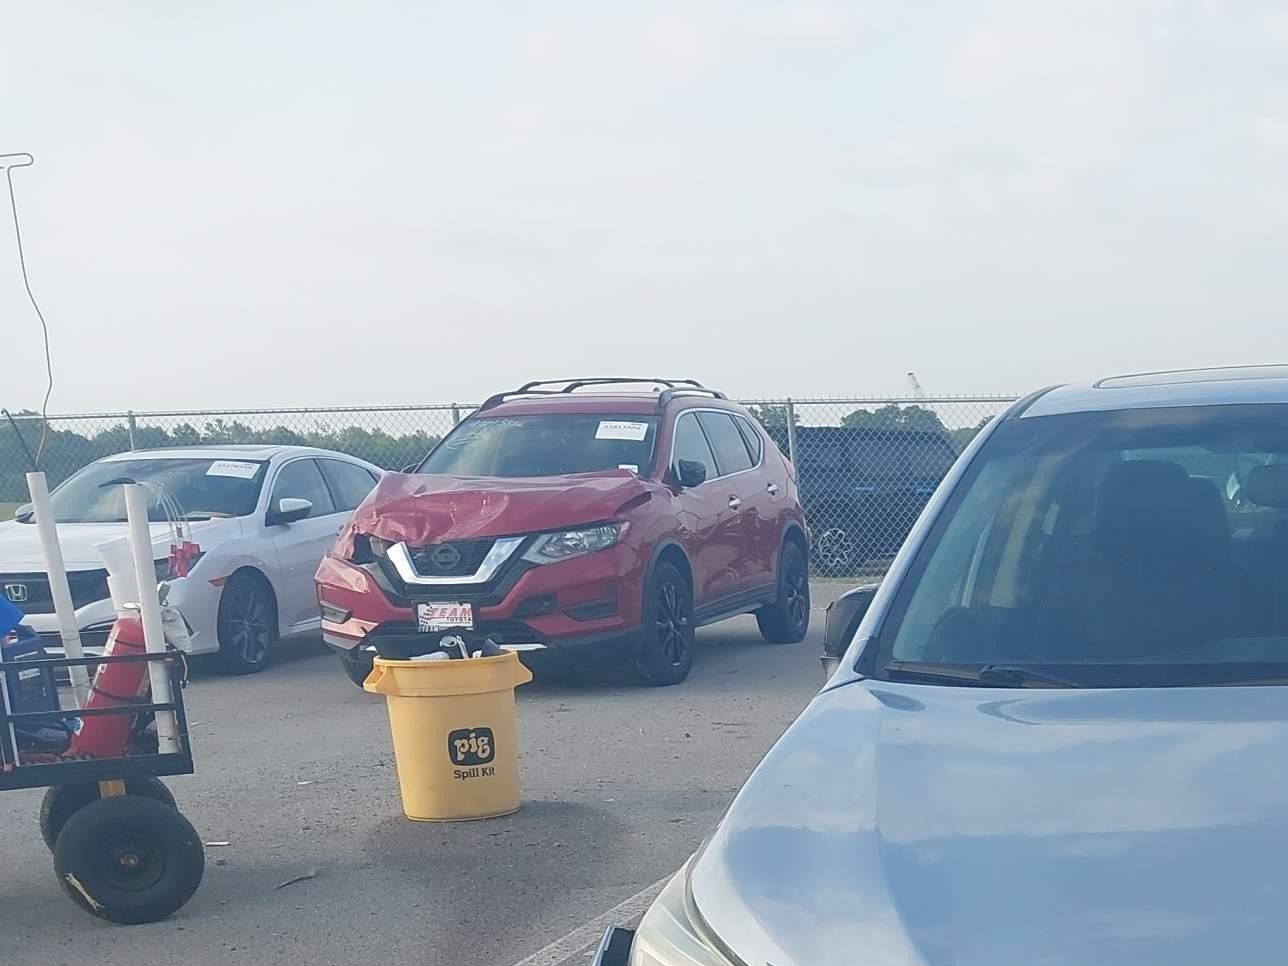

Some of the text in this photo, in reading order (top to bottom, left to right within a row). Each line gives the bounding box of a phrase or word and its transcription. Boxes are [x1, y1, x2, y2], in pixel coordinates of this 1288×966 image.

[431, 607, 471, 617] TEAM
[454, 732, 490, 761] pig
[453, 766, 495, 780] Spill Kit
